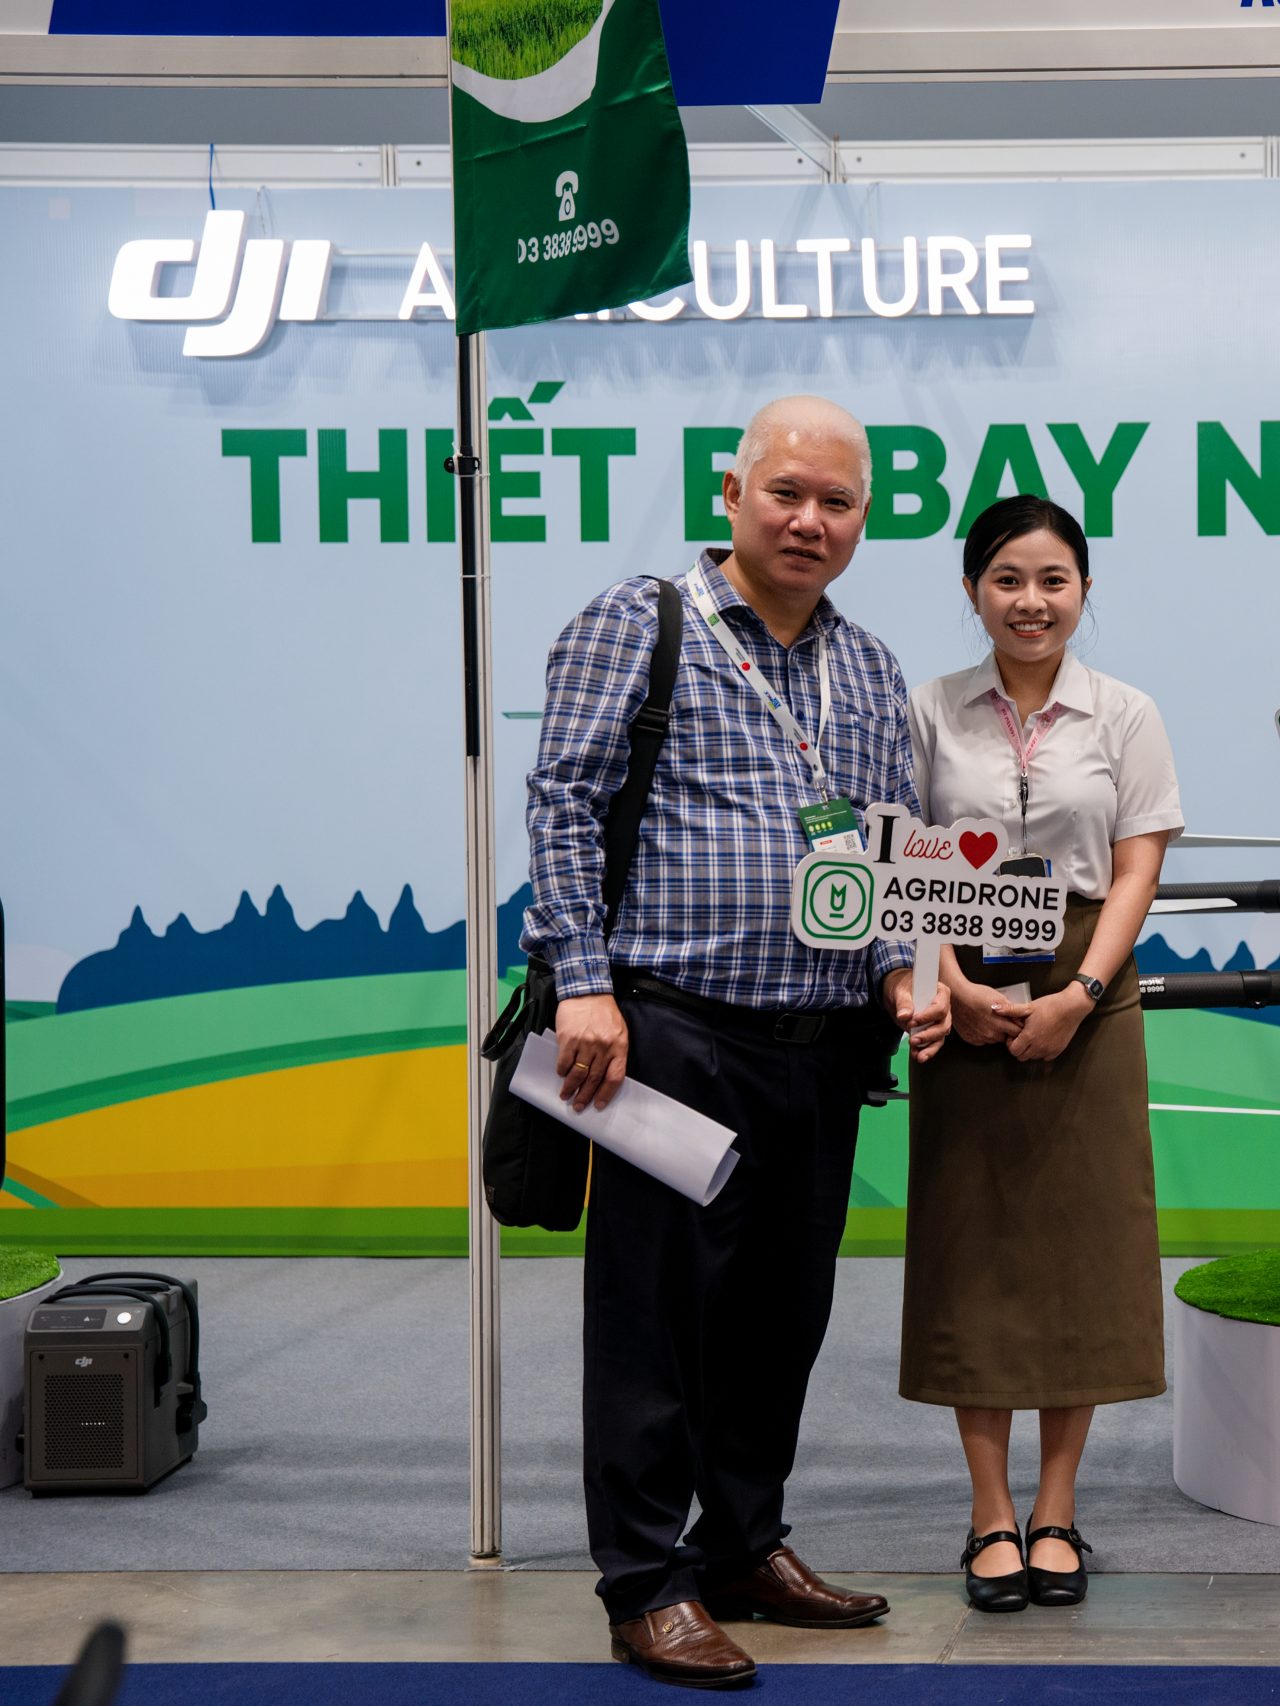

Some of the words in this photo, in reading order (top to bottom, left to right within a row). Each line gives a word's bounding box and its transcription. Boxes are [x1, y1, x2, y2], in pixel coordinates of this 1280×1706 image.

[542, 230, 573, 261] 3838
[397, 234, 1036, 321] AULTURE
[221, 381, 637, 544] THIẾT
[864, 422, 1151, 541] BAY
[873, 814, 900, 865] I
[903, 829, 954, 861] love
[883, 876, 1060, 911] AGRIDRONE
[880, 909, 915, 933] 03
[921, 911, 983, 937] 3838
[991, 916, 1057, 942] 9999
